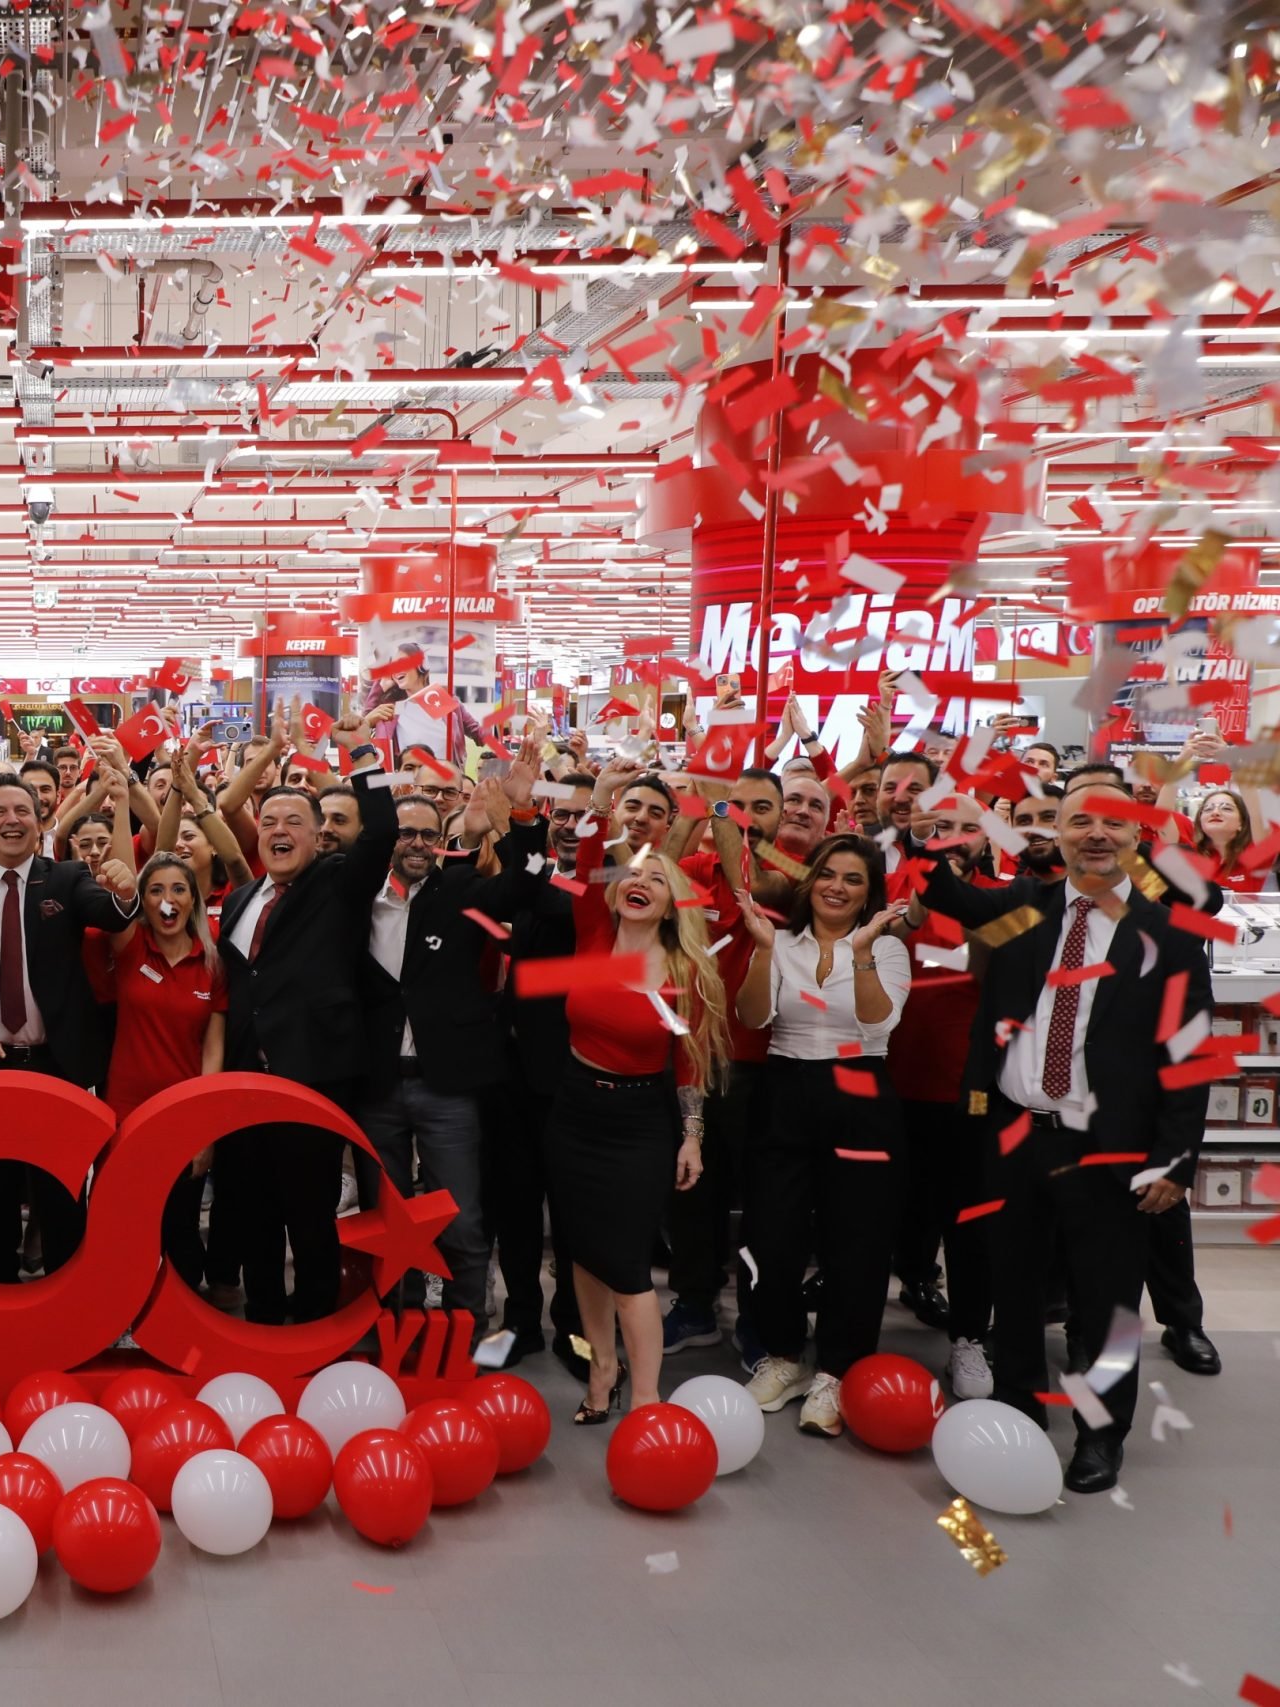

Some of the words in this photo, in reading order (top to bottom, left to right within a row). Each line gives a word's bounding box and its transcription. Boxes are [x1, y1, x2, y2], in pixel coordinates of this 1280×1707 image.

[1132, 592, 1231, 614] OPTÖR
[1231, 591, 1280, 611] HİZME
[285, 640, 326, 653] KEŞFET!
[278, 661, 309, 669] ANKER
[1128, 659, 1249, 682] NTAJLI
